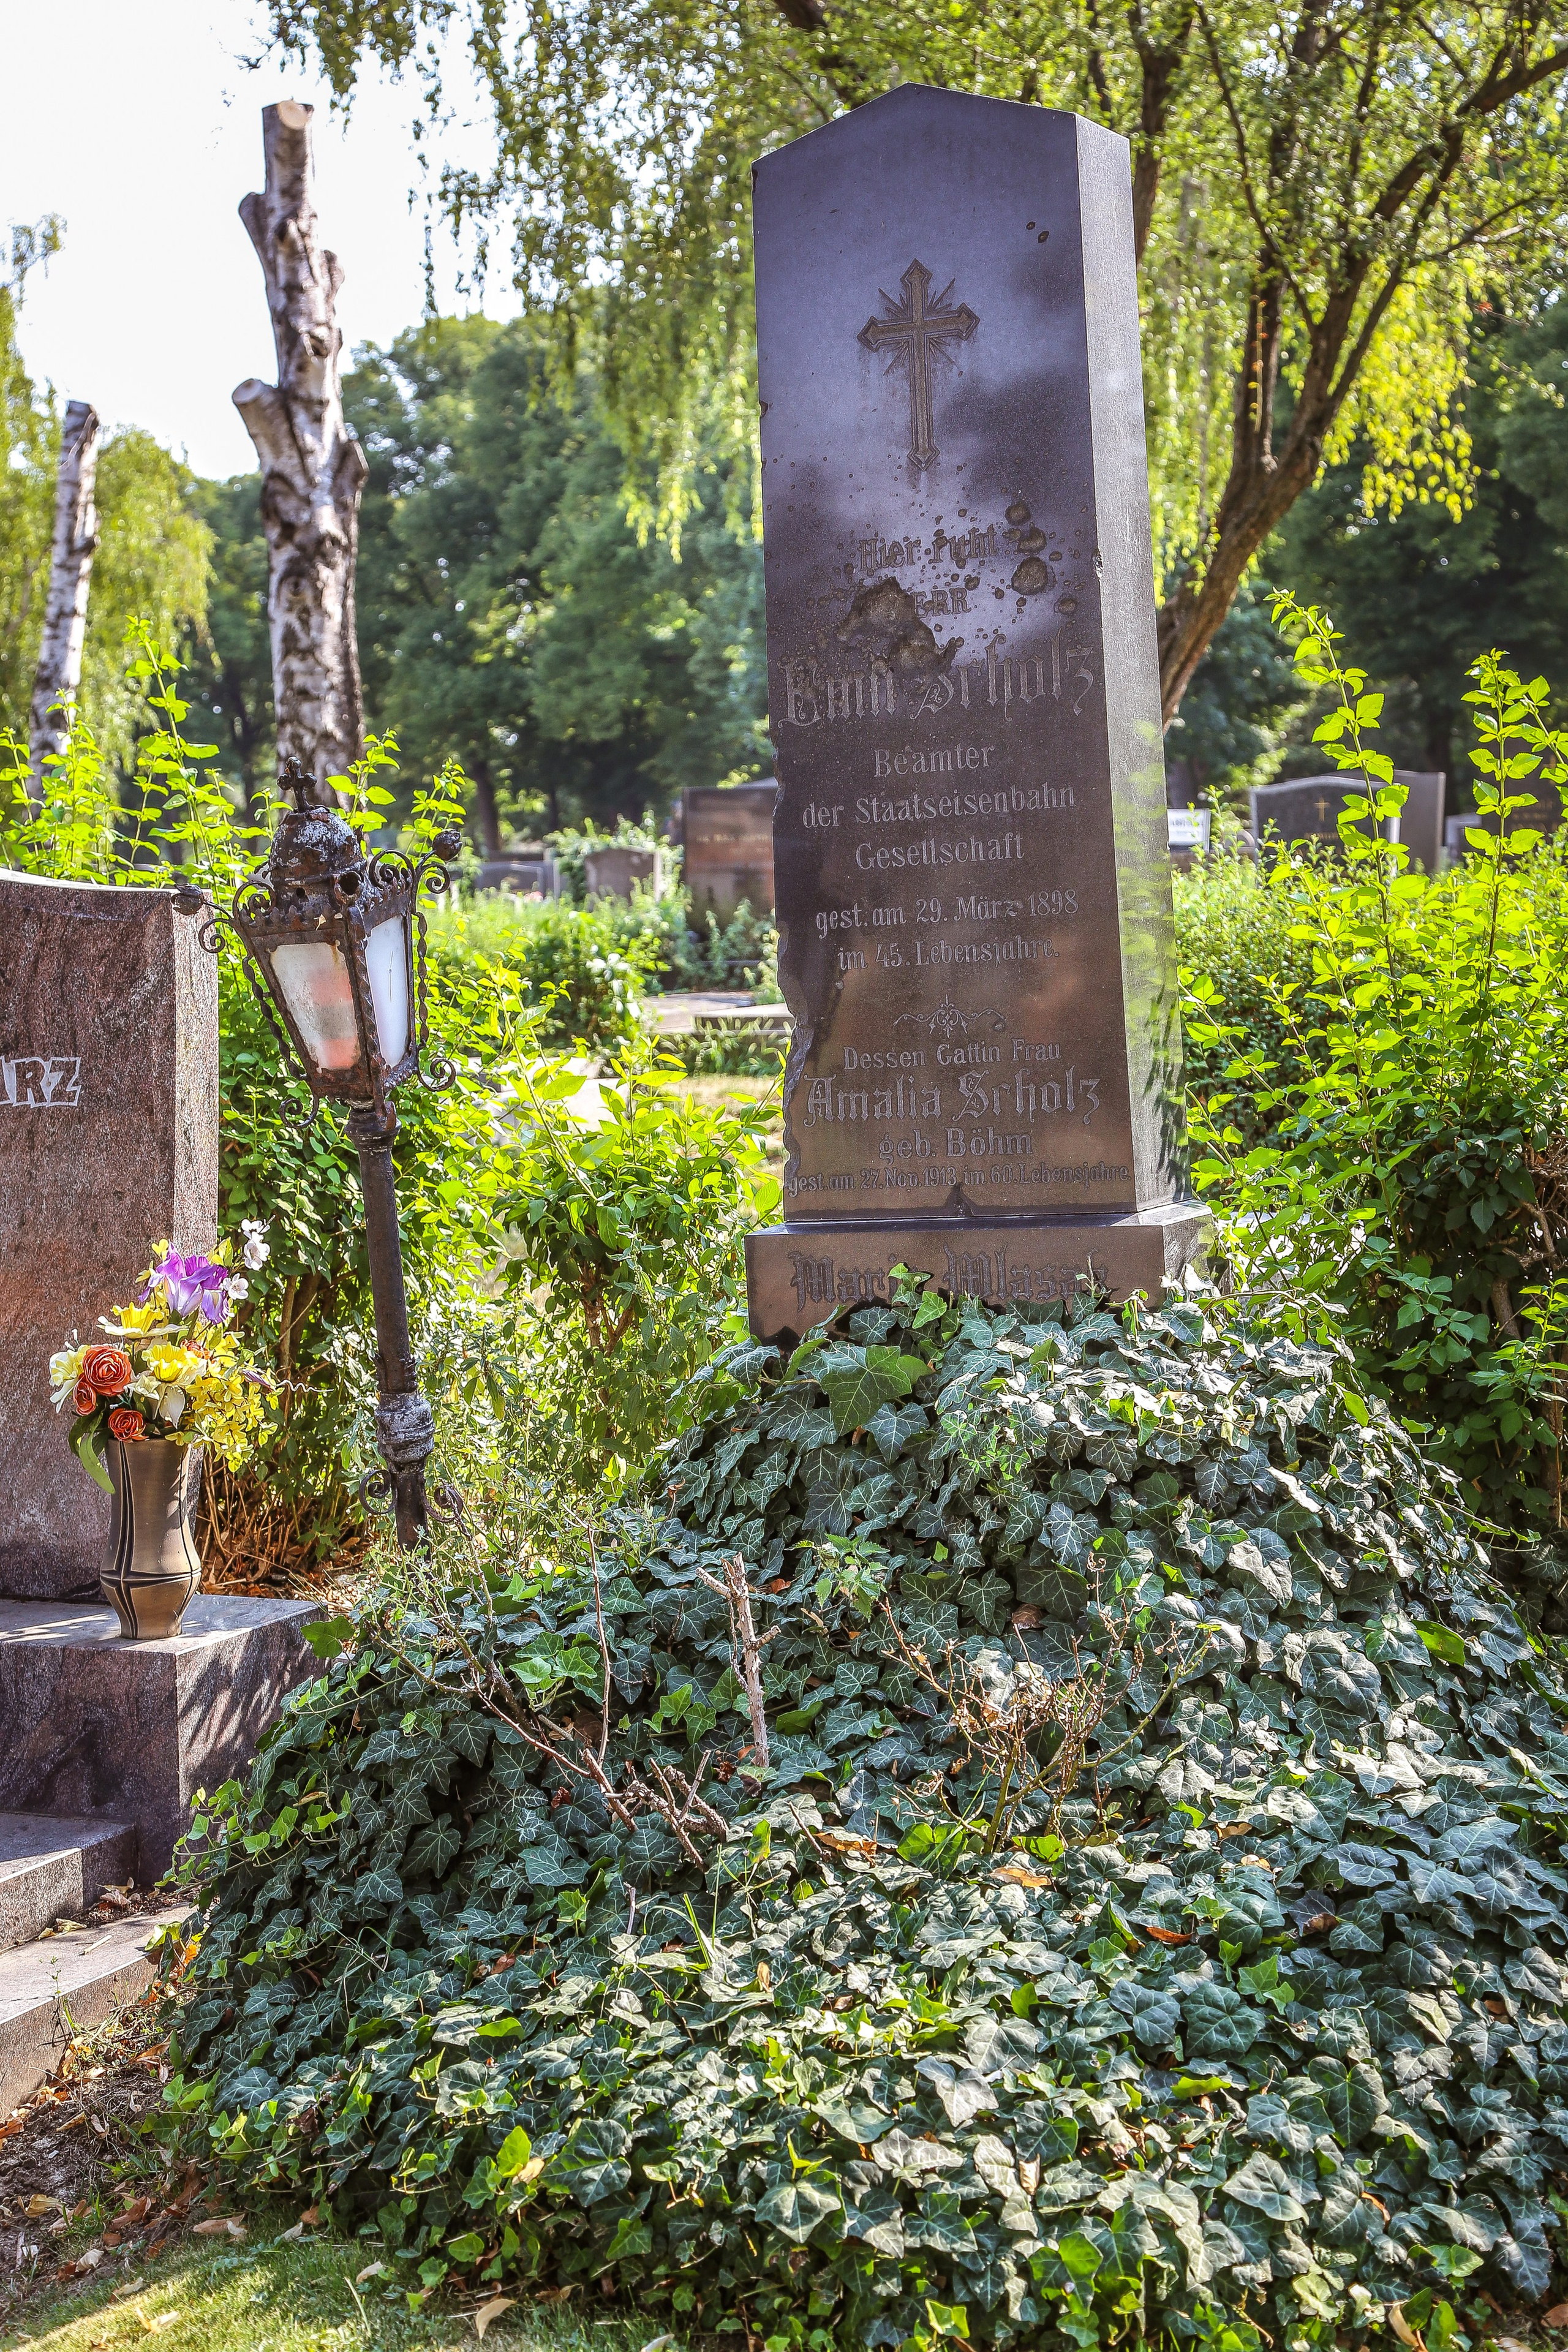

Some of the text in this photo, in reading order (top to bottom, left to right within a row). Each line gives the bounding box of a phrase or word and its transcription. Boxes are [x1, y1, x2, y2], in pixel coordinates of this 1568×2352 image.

[859, 524, 998, 572] Hier ruht
[894, 587, 972, 619] ERR
[873, 743, 995, 778] Beamter
[802, 783, 1077, 829] der Staatseisenbahn
[855, 832, 1025, 870] Gesellschaft
[816, 889, 1079, 940] gest. am 29. März 1898
[837, 936, 1061, 971] im 45. Lebensjahre.
[843, 1039, 1061, 1071] Dessen Gattin Frau
[0, 1055, 81, 1109] RZ
[803, 1065, 1101, 1127] Amalia Scholz
[878, 1127, 1033, 1164] geb. Böhm
[922, 1166, 957, 1185] 1913
[963, 1166, 986, 1184] im
[991, 1166, 1017, 1183] 60.
[1019, 1161, 1131, 1191] Lebensjahre.
[787, 1251, 920, 1313] Mari
